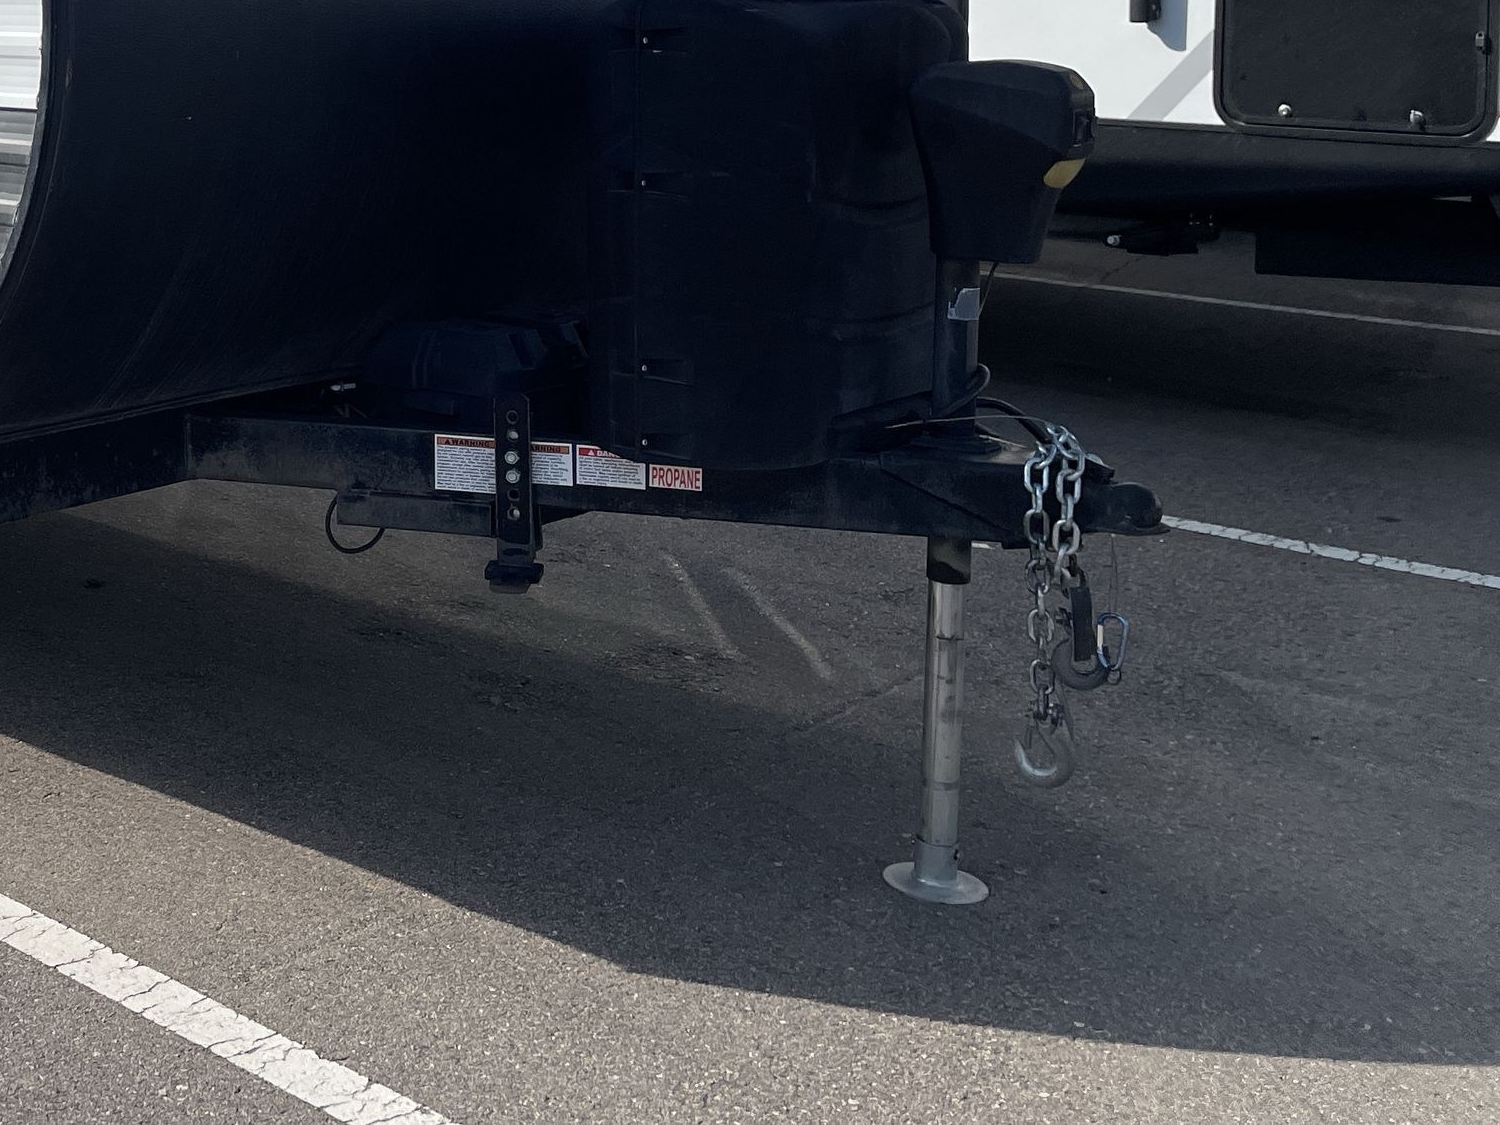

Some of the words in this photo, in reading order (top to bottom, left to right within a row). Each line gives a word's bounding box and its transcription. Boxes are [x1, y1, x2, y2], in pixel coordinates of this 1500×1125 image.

[450, 438, 491, 448] WARNING
[530, 444, 561, 453] ARNING
[651, 466, 701, 489] PROPANE
